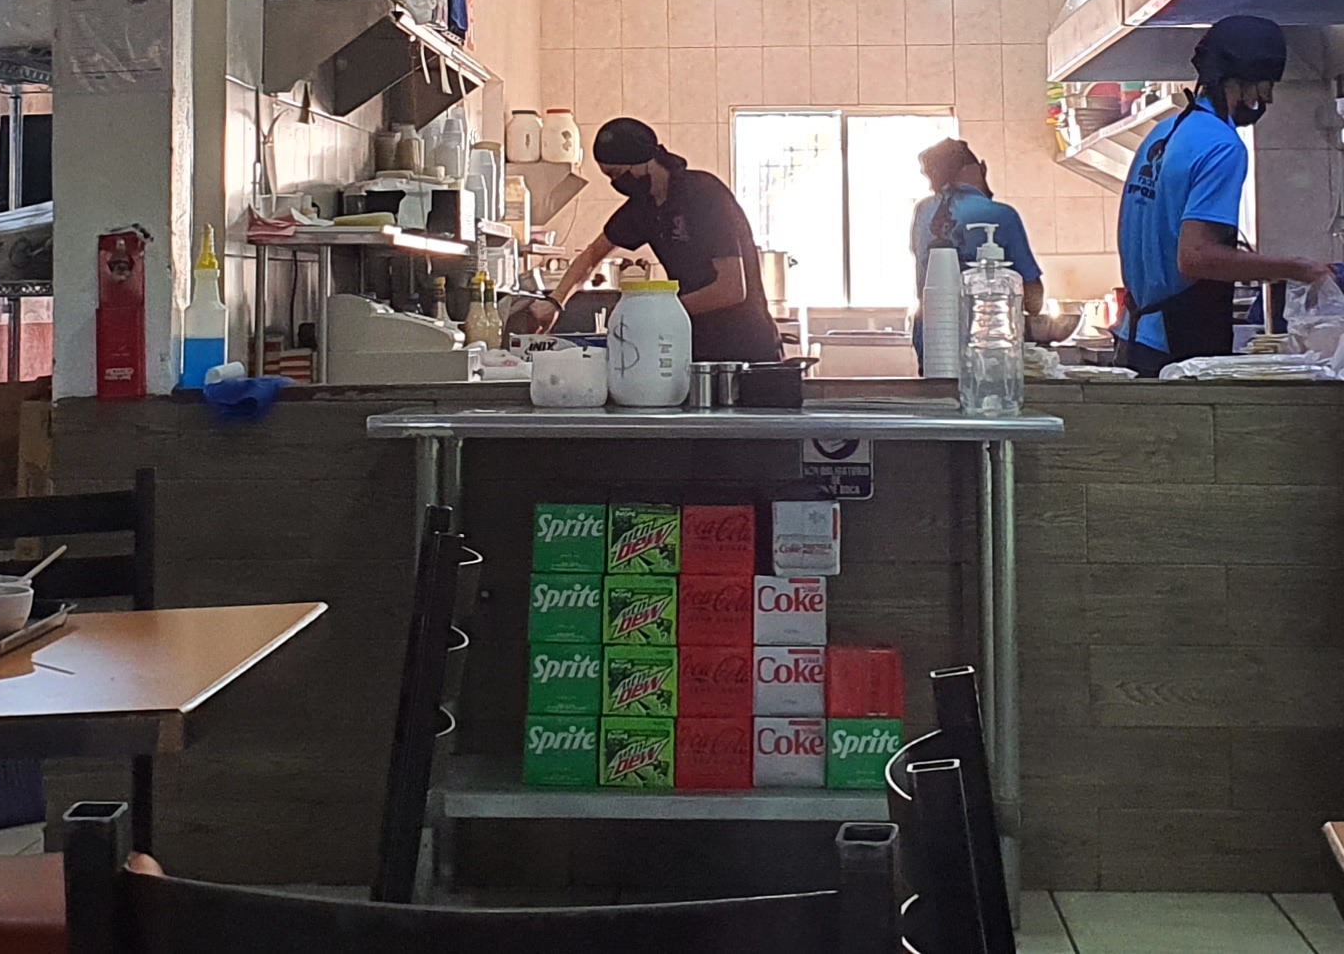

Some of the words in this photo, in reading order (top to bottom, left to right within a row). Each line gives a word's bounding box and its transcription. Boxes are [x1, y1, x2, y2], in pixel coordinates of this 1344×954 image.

[537, 513, 604, 542] Sprite
[533, 583, 600, 613] Sprite
[758, 586, 824, 613] Coke
[533, 654, 600, 683] Sprite
[757, 656, 824, 684] Coke
[528, 725, 596, 754] Sprite
[758, 728, 824, 756] Coke
[832, 728, 900, 759] Sprite
